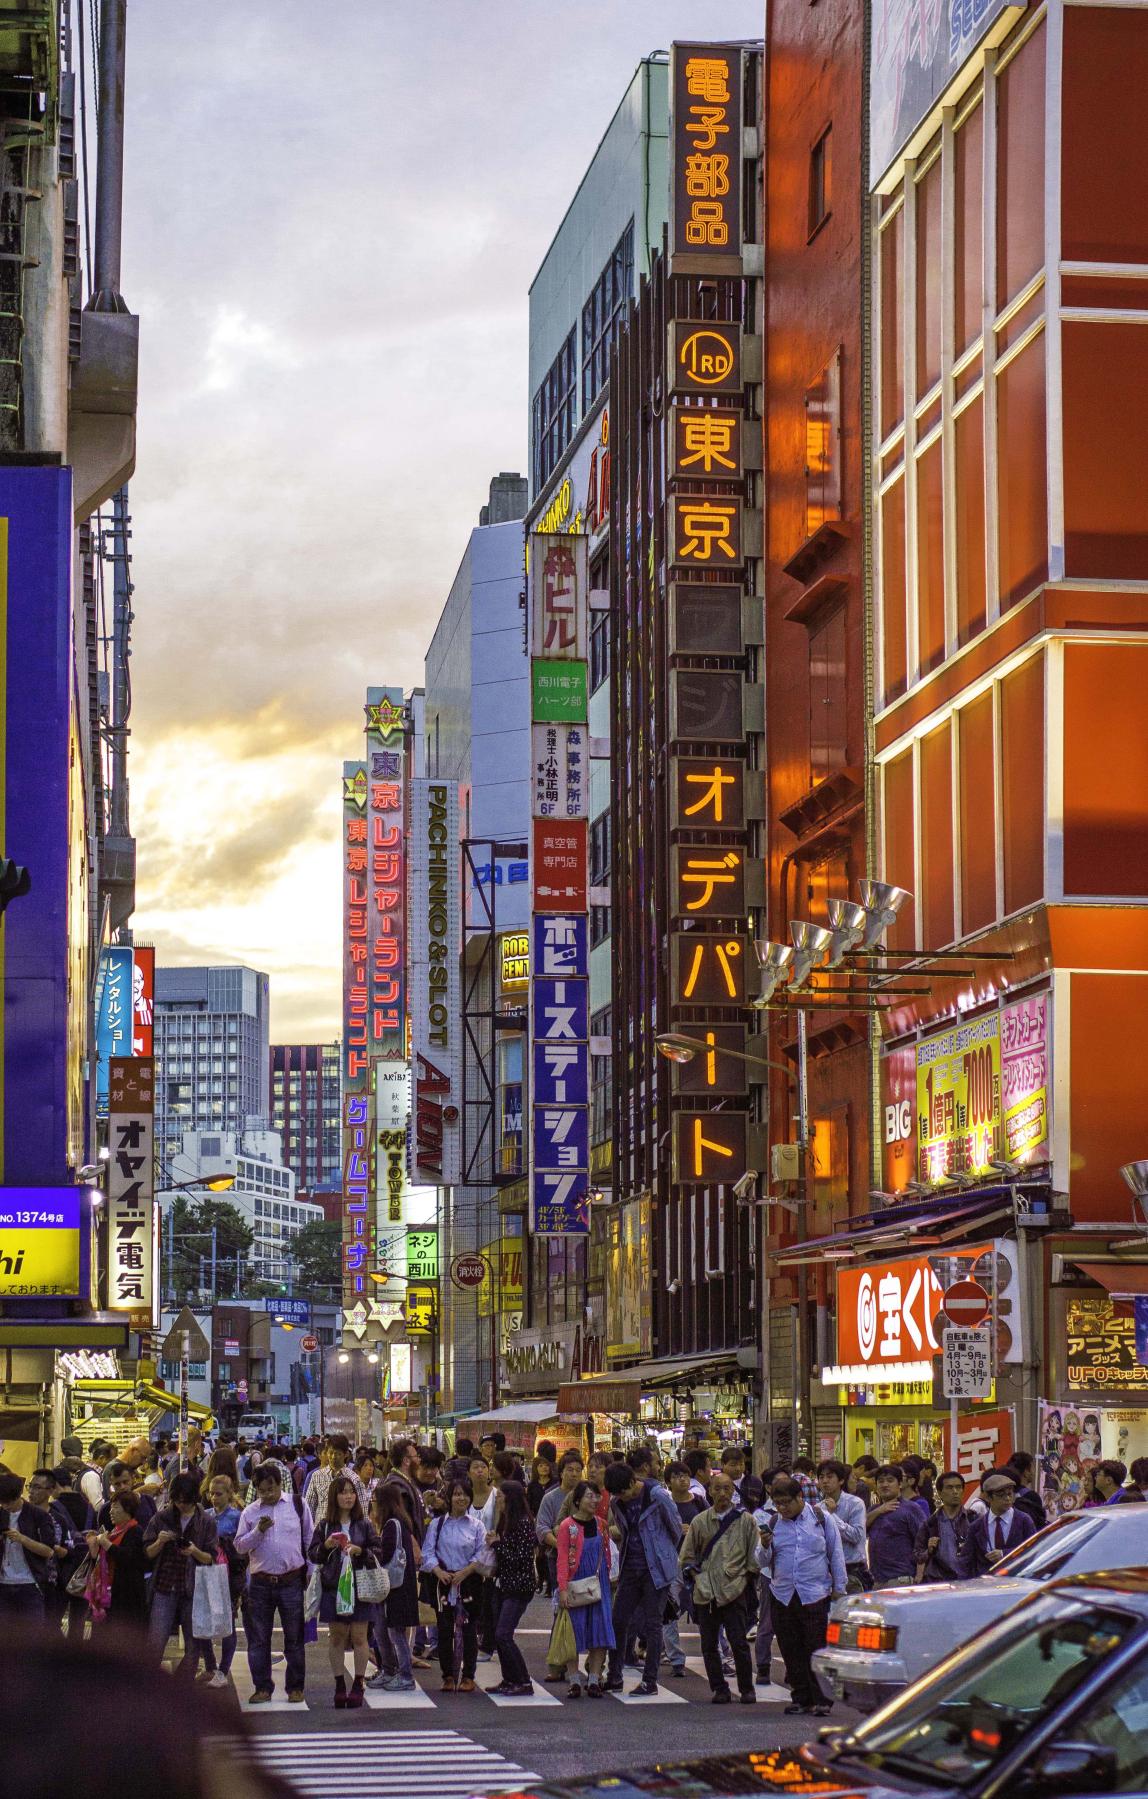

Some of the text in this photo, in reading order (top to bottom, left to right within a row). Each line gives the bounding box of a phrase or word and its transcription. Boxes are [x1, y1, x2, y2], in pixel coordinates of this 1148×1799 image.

[686, 58, 730, 245] 電子部品
[538, 677, 581, 688] 西川電子
[538, 695, 581, 706] パーツ部
[540, 803, 555, 815] 6F
[567, 804, 581, 815] 6F
[543, 837, 577, 849] 真空管
[429, 786, 448, 937] PACHINKO
[543, 856, 577, 868] 専門店
[371, 751, 400, 1039] 東京レジャーランド
[429, 967, 448, 1046] SLOT
[543, 917, 579, 1204] ホビーステーション
[886, 1100, 911, 1144] BIG
[348, 1096, 368, 1293] ゲームコーナー
[115, 1121, 146, 1300] オヤイデ電気
[408, 1234, 436, 1248] ネジ
[416, 1250, 427, 1260] の
[408, 1263, 436, 1277] 西川
[458, 1265, 484, 1278] 消火栓
[879, 1267, 943, 1357] 宝くじ
[1068, 1335, 1121, 1355] アニメ
[1091, 1353, 1121, 1365] グッズ
[958, 1427, 999, 1484] 宝
